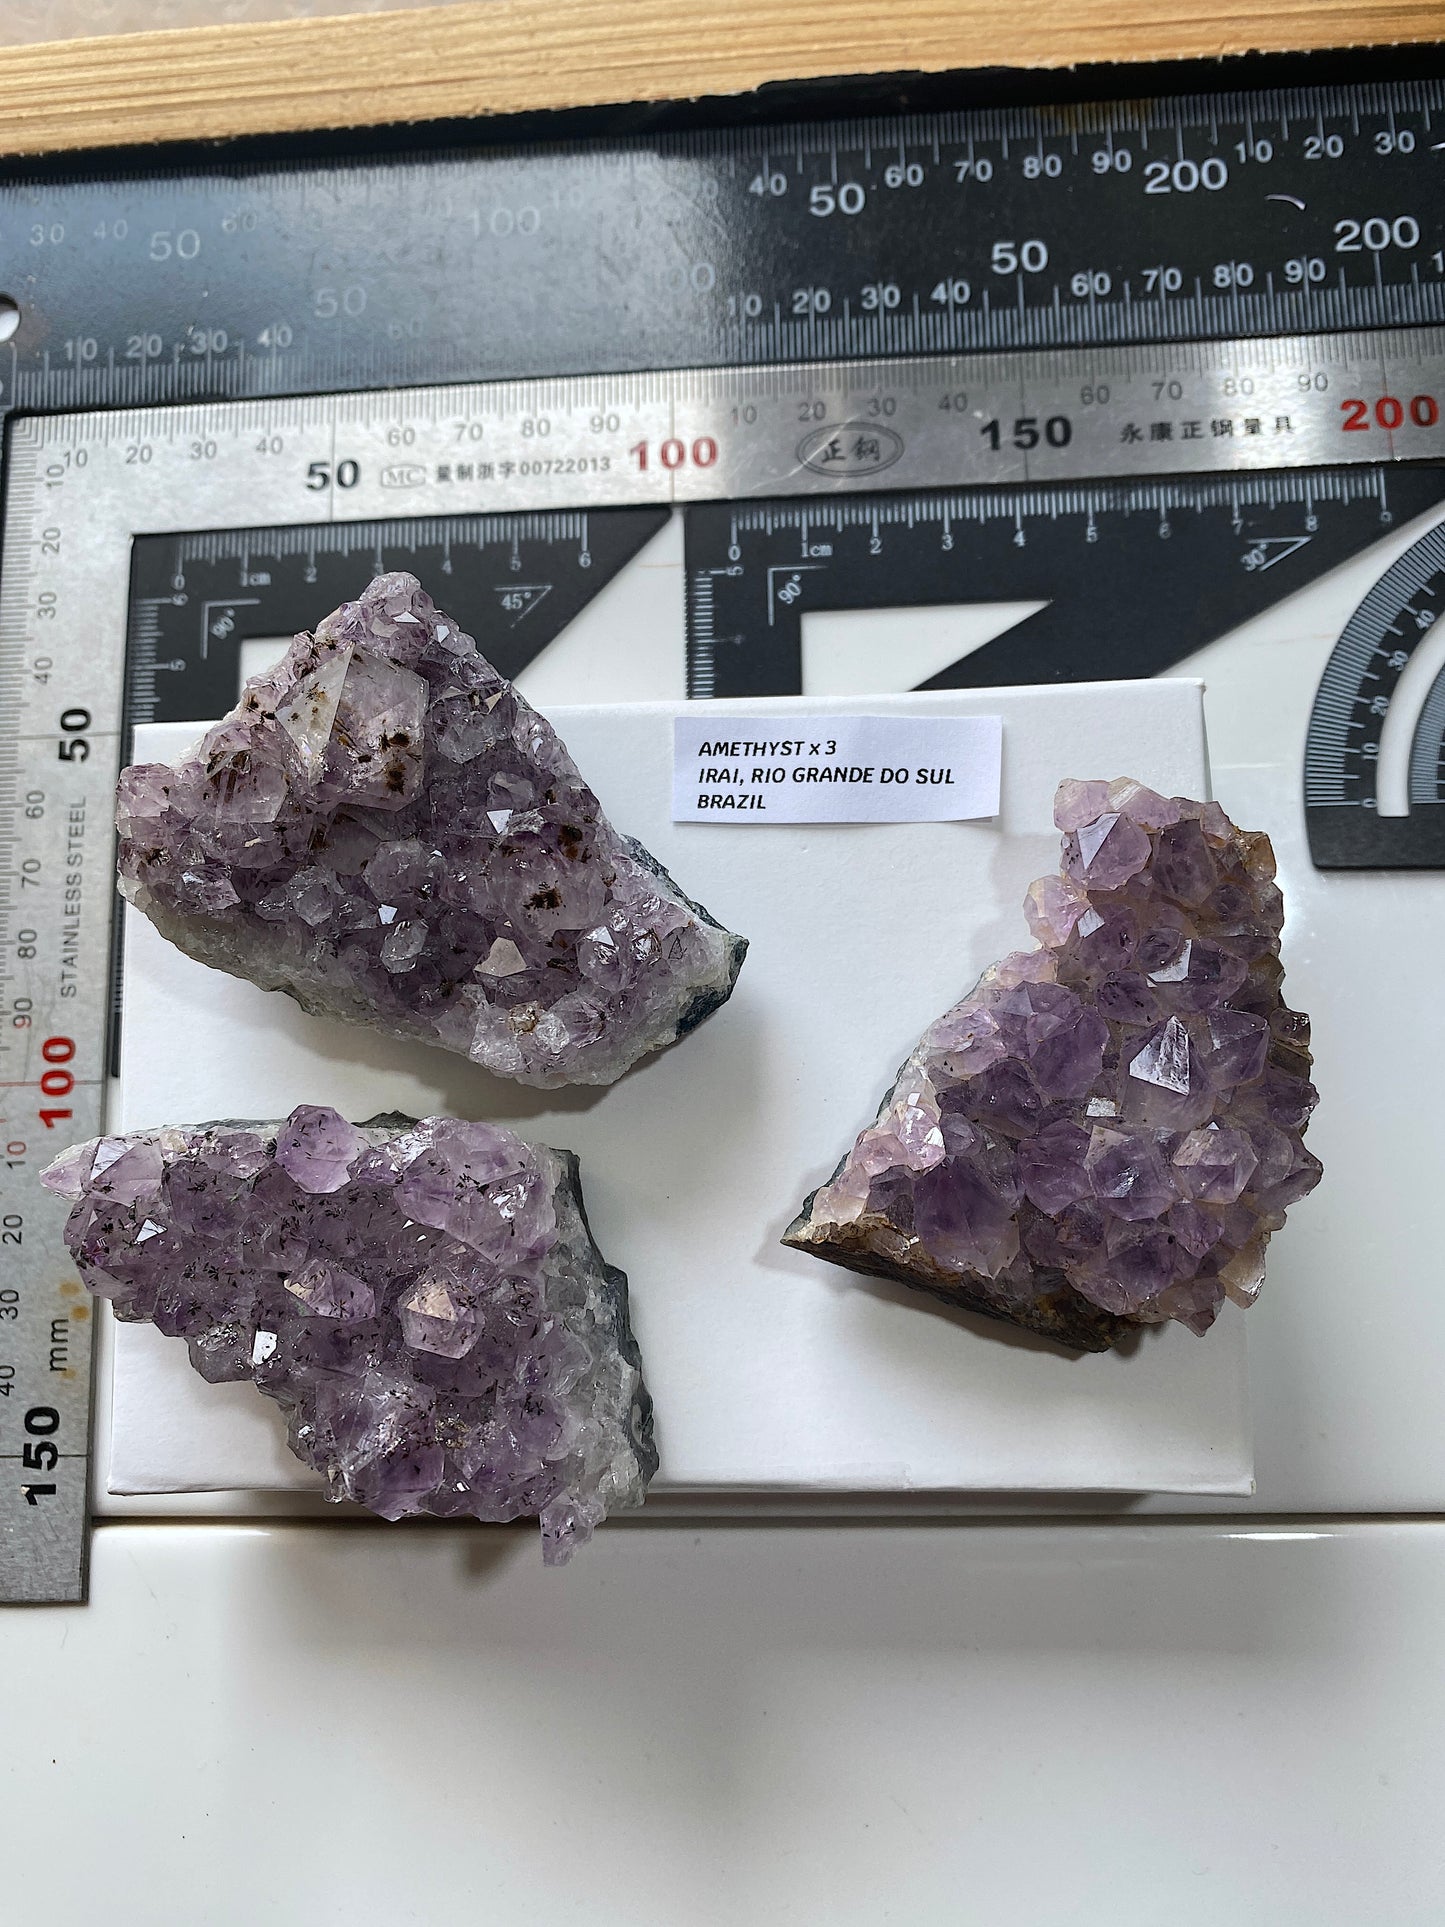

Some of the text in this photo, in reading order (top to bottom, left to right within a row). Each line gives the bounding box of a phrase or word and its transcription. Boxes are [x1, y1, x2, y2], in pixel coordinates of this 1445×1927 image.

[29, 223, 65, 247] 30
[94, 219, 128, 241] 40
[150, 229, 200, 262] 50
[222, 210, 257, 234] 60
[471, 205, 541, 239] 100
[749, 173, 787, 197] 40
[809, 183, 866, 217] 50
[885, 163, 924, 189] 60
[953, 159, 993, 183] 70
[1023, 154, 1062, 179] 80
[1091, 149, 1132, 174] 90
[1143, 157, 1229, 195] 200
[1234, 139, 1273, 164] 10
[1303, 134, 1345, 160] 20
[1373, 129, 1416, 155] 30
[314, 287, 367, 319] 50
[991, 240, 1049, 275] 50
[1333, 215, 1420, 253] 200
[64, 338, 98, 361] 10
[126, 334, 163, 358] 20
[191, 330, 228, 354] 30
[257, 324, 293, 348] 40
[727, 294, 763, 318] 10
[792, 287, 832, 314] 20
[861, 284, 901, 310] 30
[931, 280, 971, 305] 40
[1070, 271, 1111, 297] 60
[1141, 267, 1183, 292] 70
[1212, 262, 1254, 288] 80
[1284, 258, 1327, 284] 90
[1432, 250, 1445, 273] 1
[63, 372, 1329, 469] 10 20 30 40 60 70 80 90 10 20 30 40 60 70 80 90
[306, 395, 1439, 492] 50 100 150 200
[45, 463, 65, 489] 10
[42, 526, 62, 556] 20
[728, 545, 741, 561] 0
[869, 538, 882, 554] 2
[941, 533, 954, 551] 3
[1013, 530, 1026, 547] 4
[1086, 526, 1098, 543] 5
[1159, 521, 1171, 539] 6
[1231, 518, 1243, 535] 7
[1305, 514, 1318, 532] 8
[304, 565, 317, 584] 2
[442, 559, 453, 575] 4
[510, 555, 522, 571] 5
[579, 552, 592, 568] 6
[37, 592, 57, 620] 30
[1415, 609, 1436, 629] 40
[34, 656, 53, 684] 40
[1388, 650, 1409, 671] 30
[1371, 696, 1390, 716] 20
[58, 708, 91, 762] 50
[698, 740, 805, 757] AMETHYST
[825, 740, 837, 756] 3
[1363, 742, 1378, 760] 10
[698, 766, 955, 787] IRAI, RIO GRANDE DO SUL
[26, 790, 45, 819] 60
[697, 794, 767, 810] BRAZIL
[1363, 798, 1376, 808] 0
[21, 858, 41, 889] 70
[61, 796, 86, 999] STAINLESS STEEL
[17, 928, 37, 960] 80
[12, 997, 33, 1030] 90
[39, 1036, 76, 1129] 100
[7, 1140, 27, 1170] 10
[2, 1213, 23, 1245] 20
[0, 1288, 20, 1321] 30
[50, 1318, 69, 1372] mm
[0, 1366, 16, 1397] 40
[21, 1405, 60, 1508] 150
